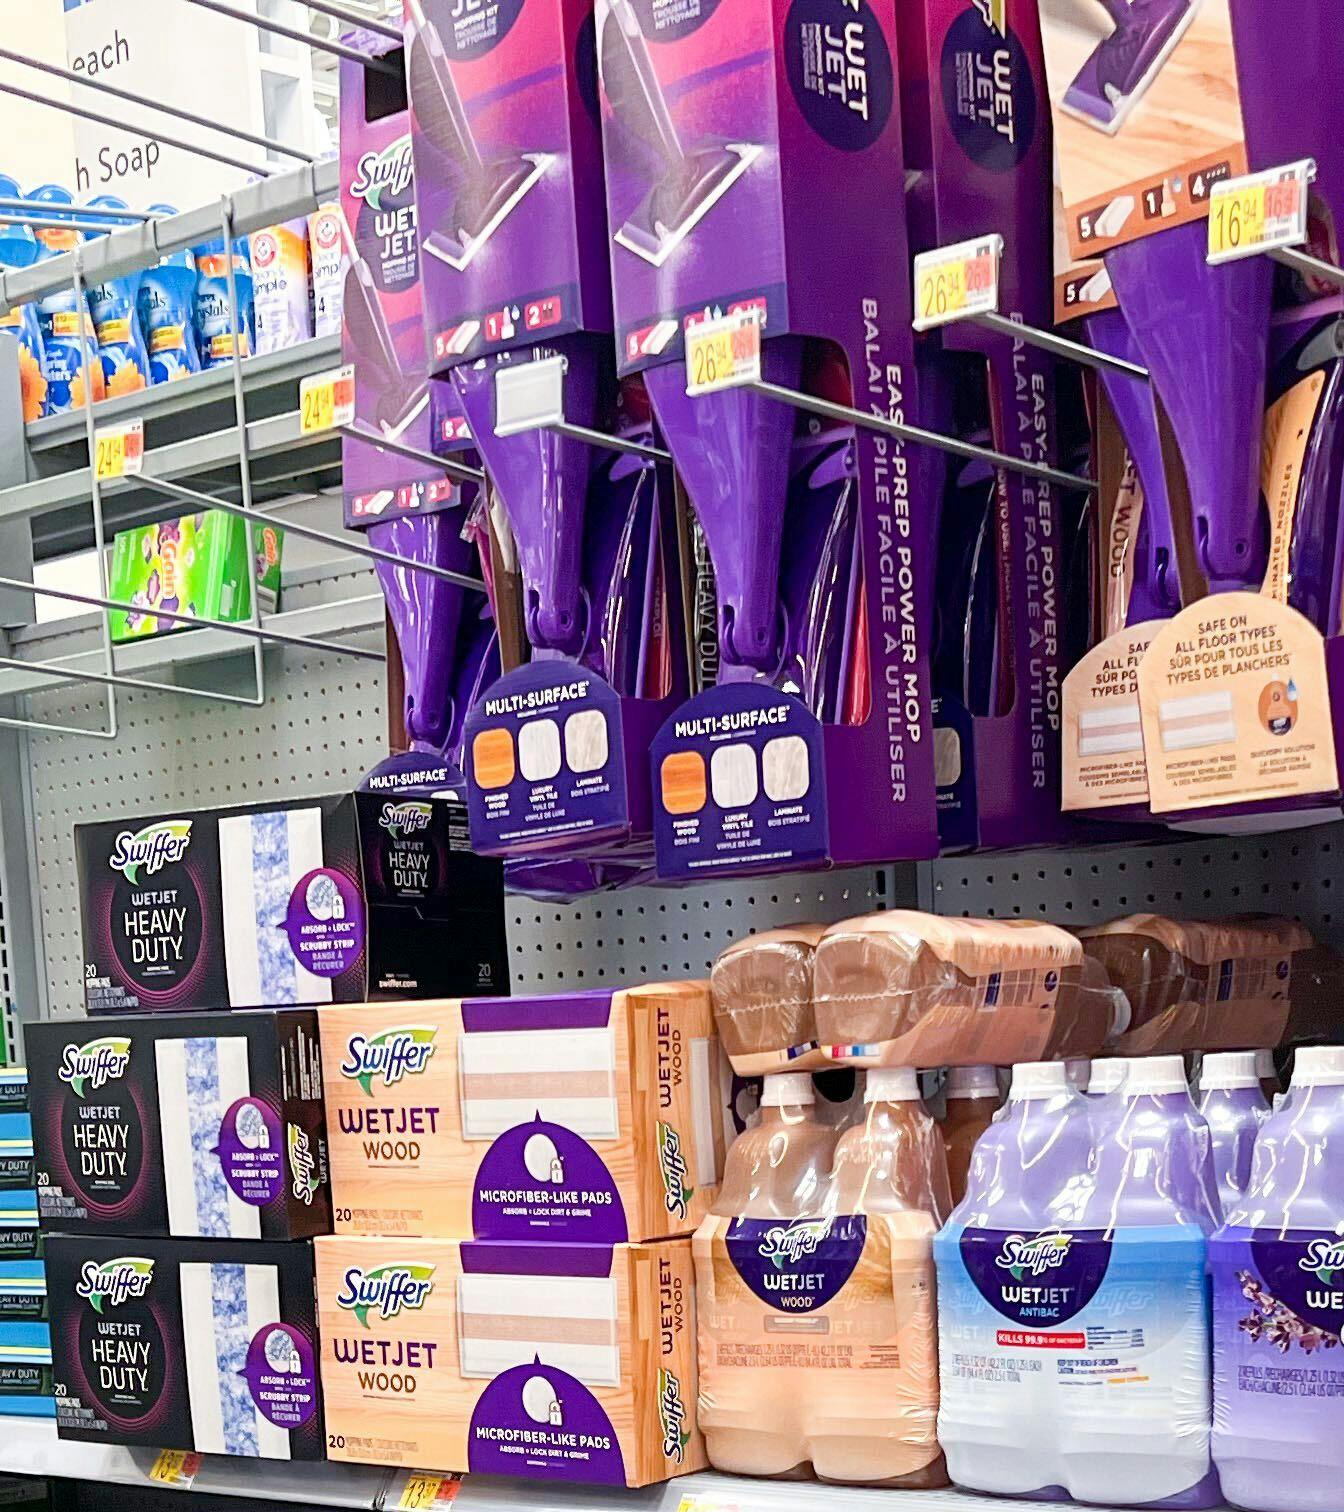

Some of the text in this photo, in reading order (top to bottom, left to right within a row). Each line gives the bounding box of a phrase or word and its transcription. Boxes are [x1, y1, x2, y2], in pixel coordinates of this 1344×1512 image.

[825, 22, 848, 100] JET
[844, 22, 868, 120] WET
[100, 140, 160, 185] Soap
[375, 213, 417, 239] WET
[380, 239, 415, 256] JET
[161, 541, 177, 597] Gain
[1175, 625, 1277, 652] ALL FLOOR TYPES
[1198, 616, 1247, 634] SAFE ON
[876, 515, 905, 801] FACILE À UTILISER
[897, 565, 920, 743] POWER MOP
[1169, 640, 1283, 669] SÛR POUR TOUS LES
[1166, 654, 1292, 684] TYPES DE PLANCHERS
[109, 821, 193, 877] Swiffer
[131, 891, 178, 907] WETJET
[124, 909, 186, 936] HEAVY
[131, 935, 183, 962] DUTY
[342, 1025, 439, 1079] Swiffer
[338, 1107, 439, 1134] WETJET
[73, 1124, 129, 1151] HEAVY
[363, 1140, 420, 1160] WOOD
[80, 1148, 127, 1176] DUTY
[479, 1189, 612, 1205] MICROFIBER-LIKE PADS
[335, 1208, 352, 1222] 20
[764, 1273, 824, 1289] WETJET
[1019, 1307, 1060, 1318] ANTIBAC
[998, 1334, 1023, 1343] KILLS
